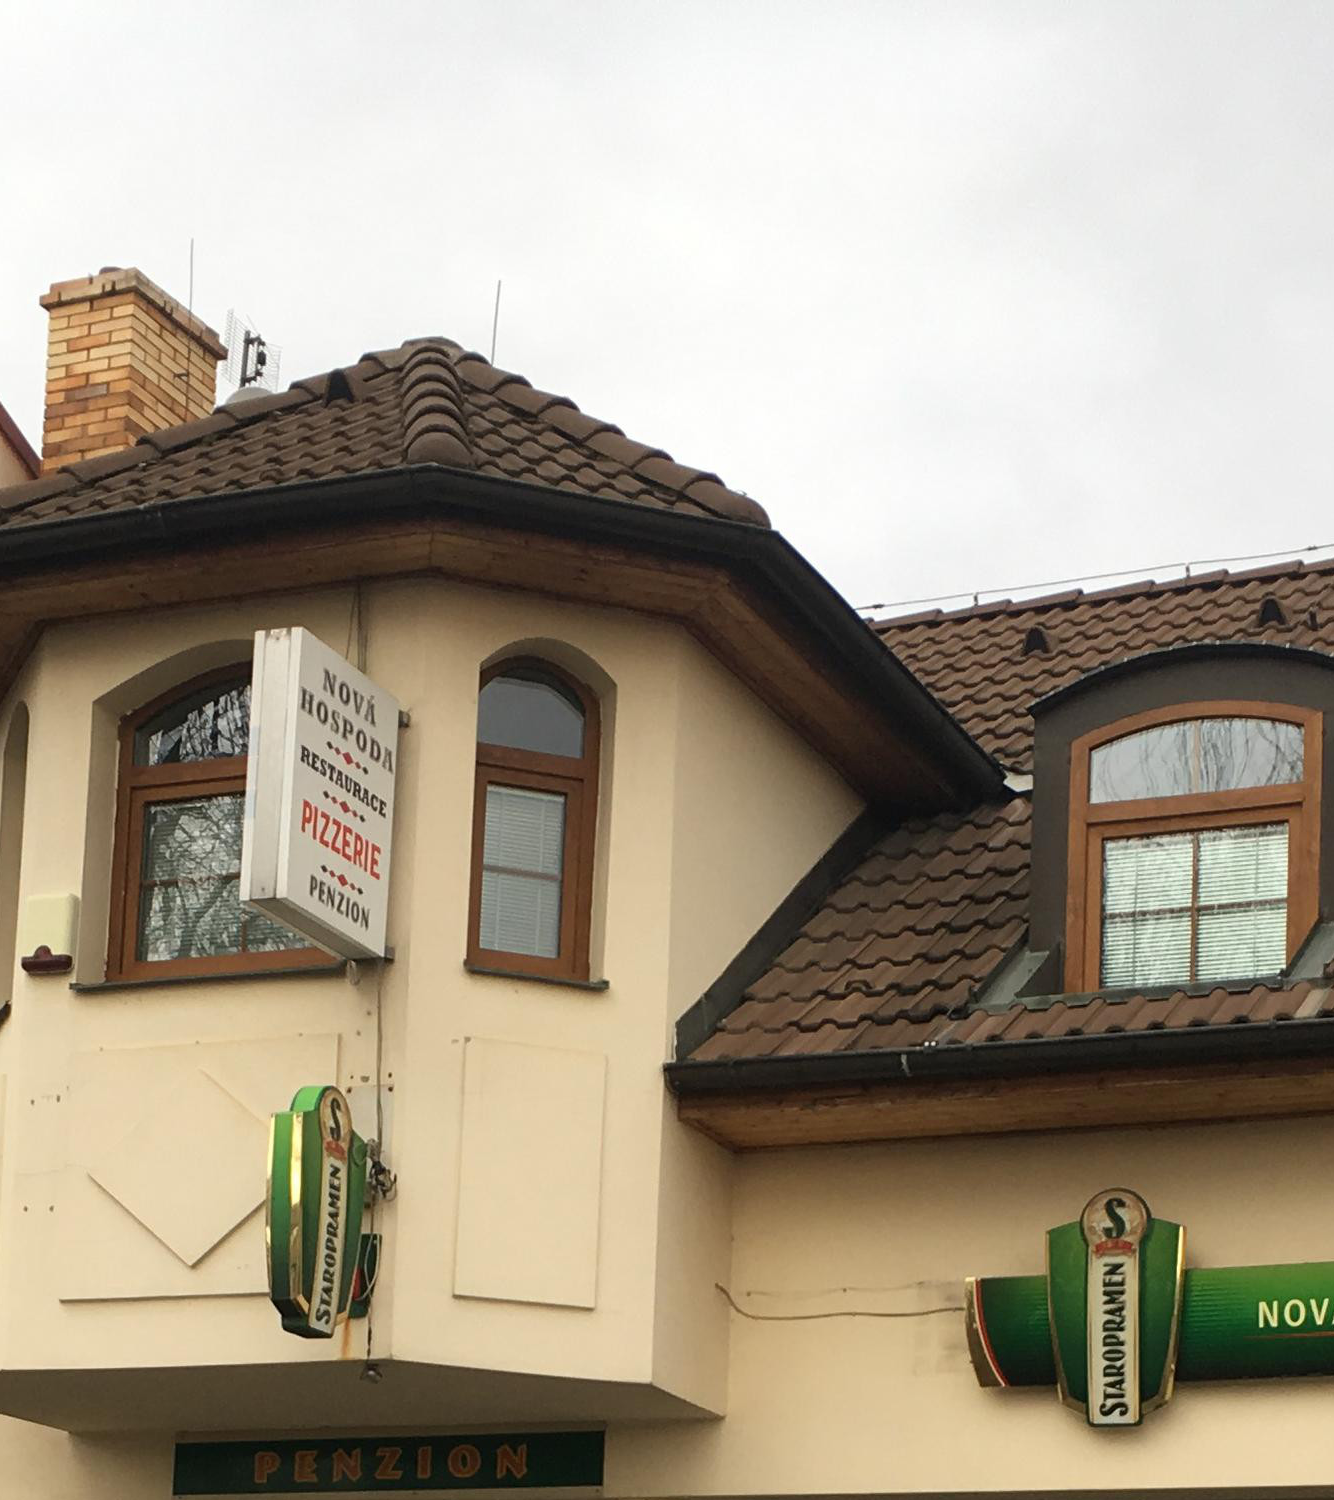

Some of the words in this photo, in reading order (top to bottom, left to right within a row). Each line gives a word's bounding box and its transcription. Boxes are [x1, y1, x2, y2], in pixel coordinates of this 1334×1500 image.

[300, 686, 394, 774] HOSPODA
[323, 668, 377, 727] NOVÁ
[300, 745, 387, 818] RESTAURACE
[301, 799, 381, 880] PIZZERIE
[309, 874, 370, 931] PENZION
[315, 1164, 342, 1326] STAROPRAMEN
[1099, 1262, 1129, 1417] STAROPRAMEN
[254, 1443, 528, 1484] PENZION
